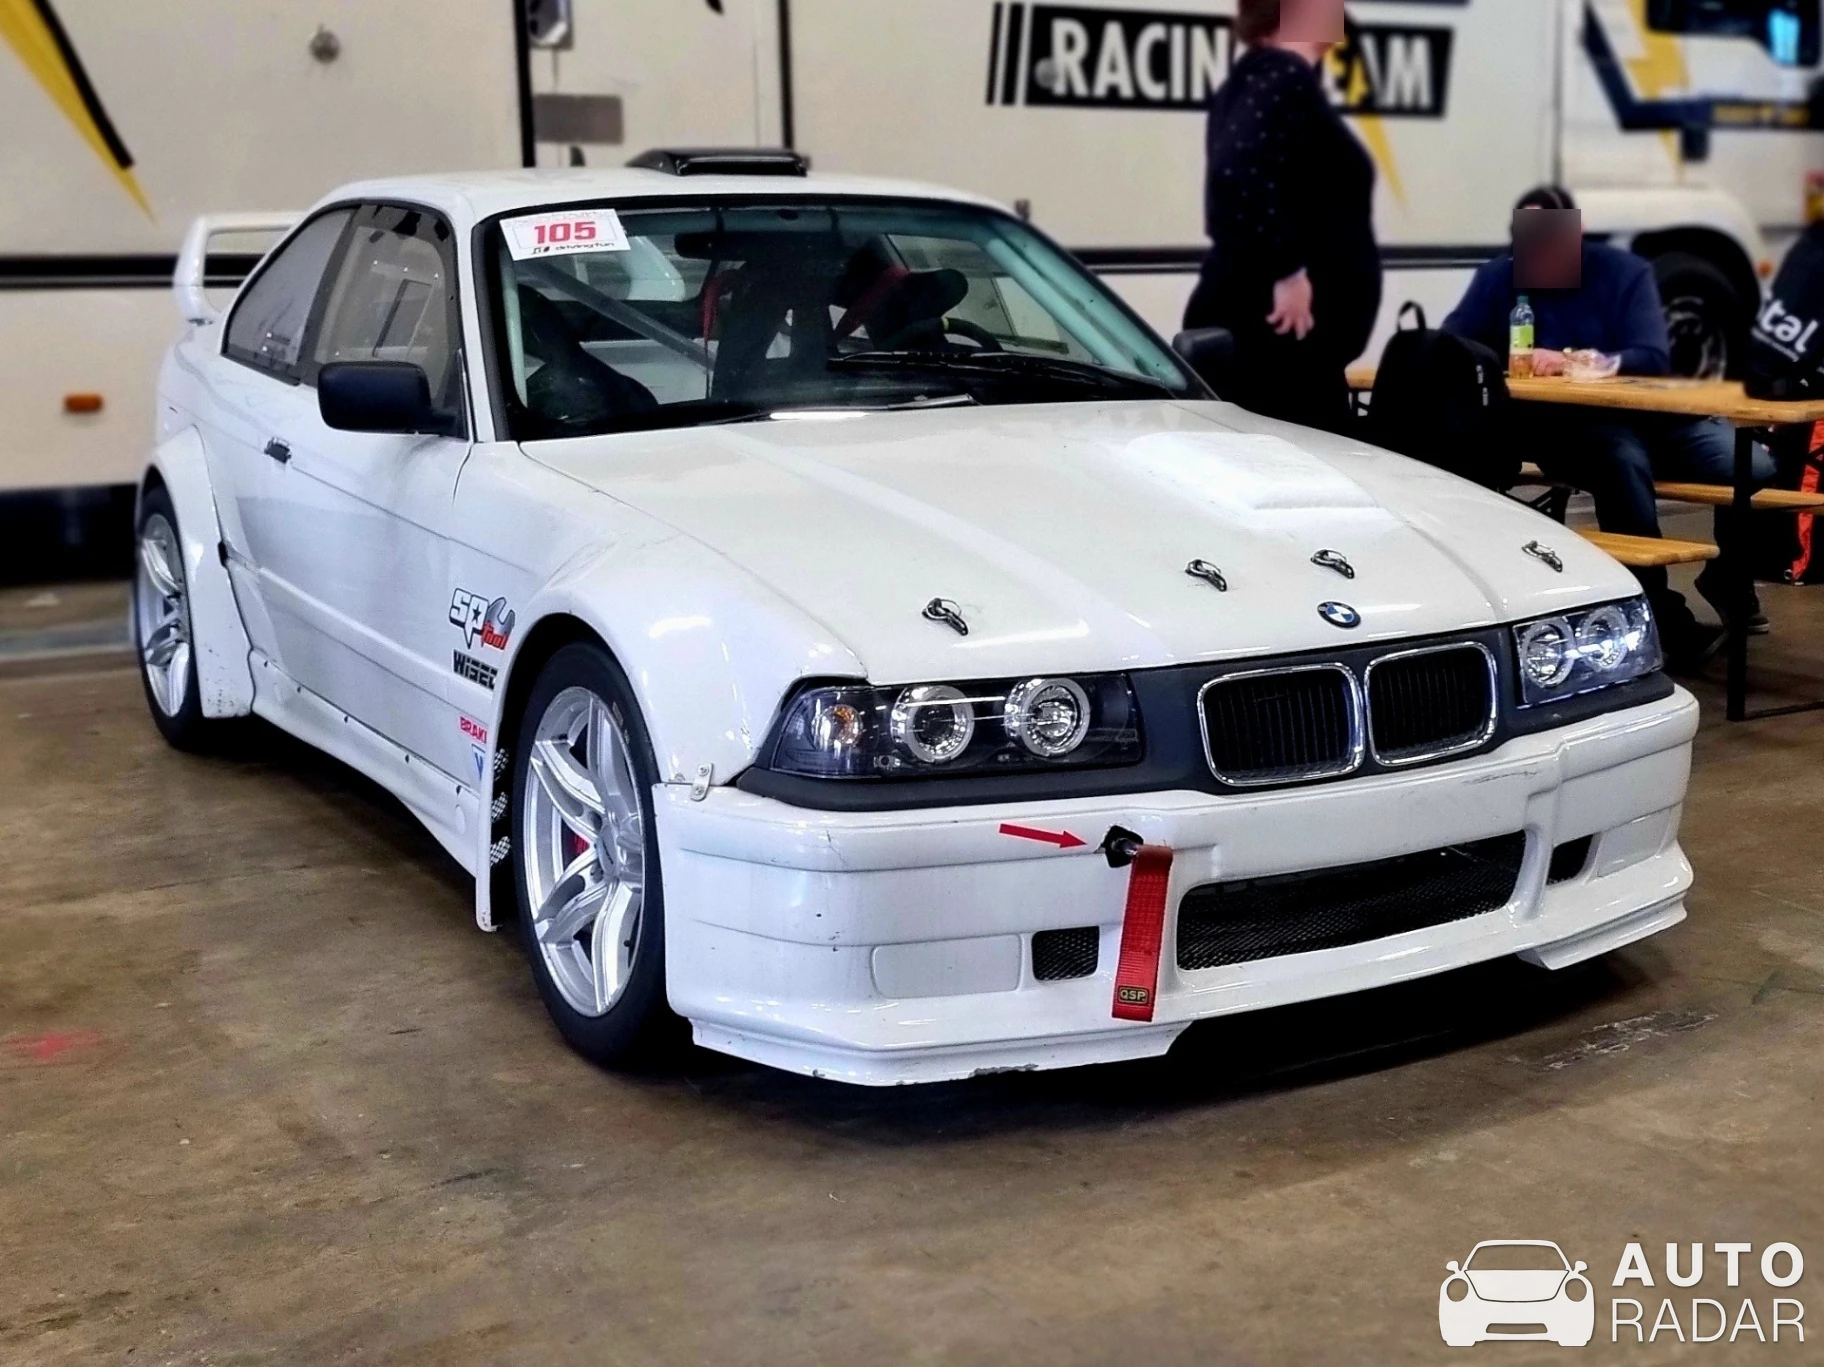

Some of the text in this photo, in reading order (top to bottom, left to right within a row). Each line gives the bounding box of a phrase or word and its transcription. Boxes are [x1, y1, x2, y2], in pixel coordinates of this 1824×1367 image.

[1051, 18, 1432, 108] RACIN EAM
[534, 221, 597, 245] 105
[1120, 989, 1147, 1001] QSP
